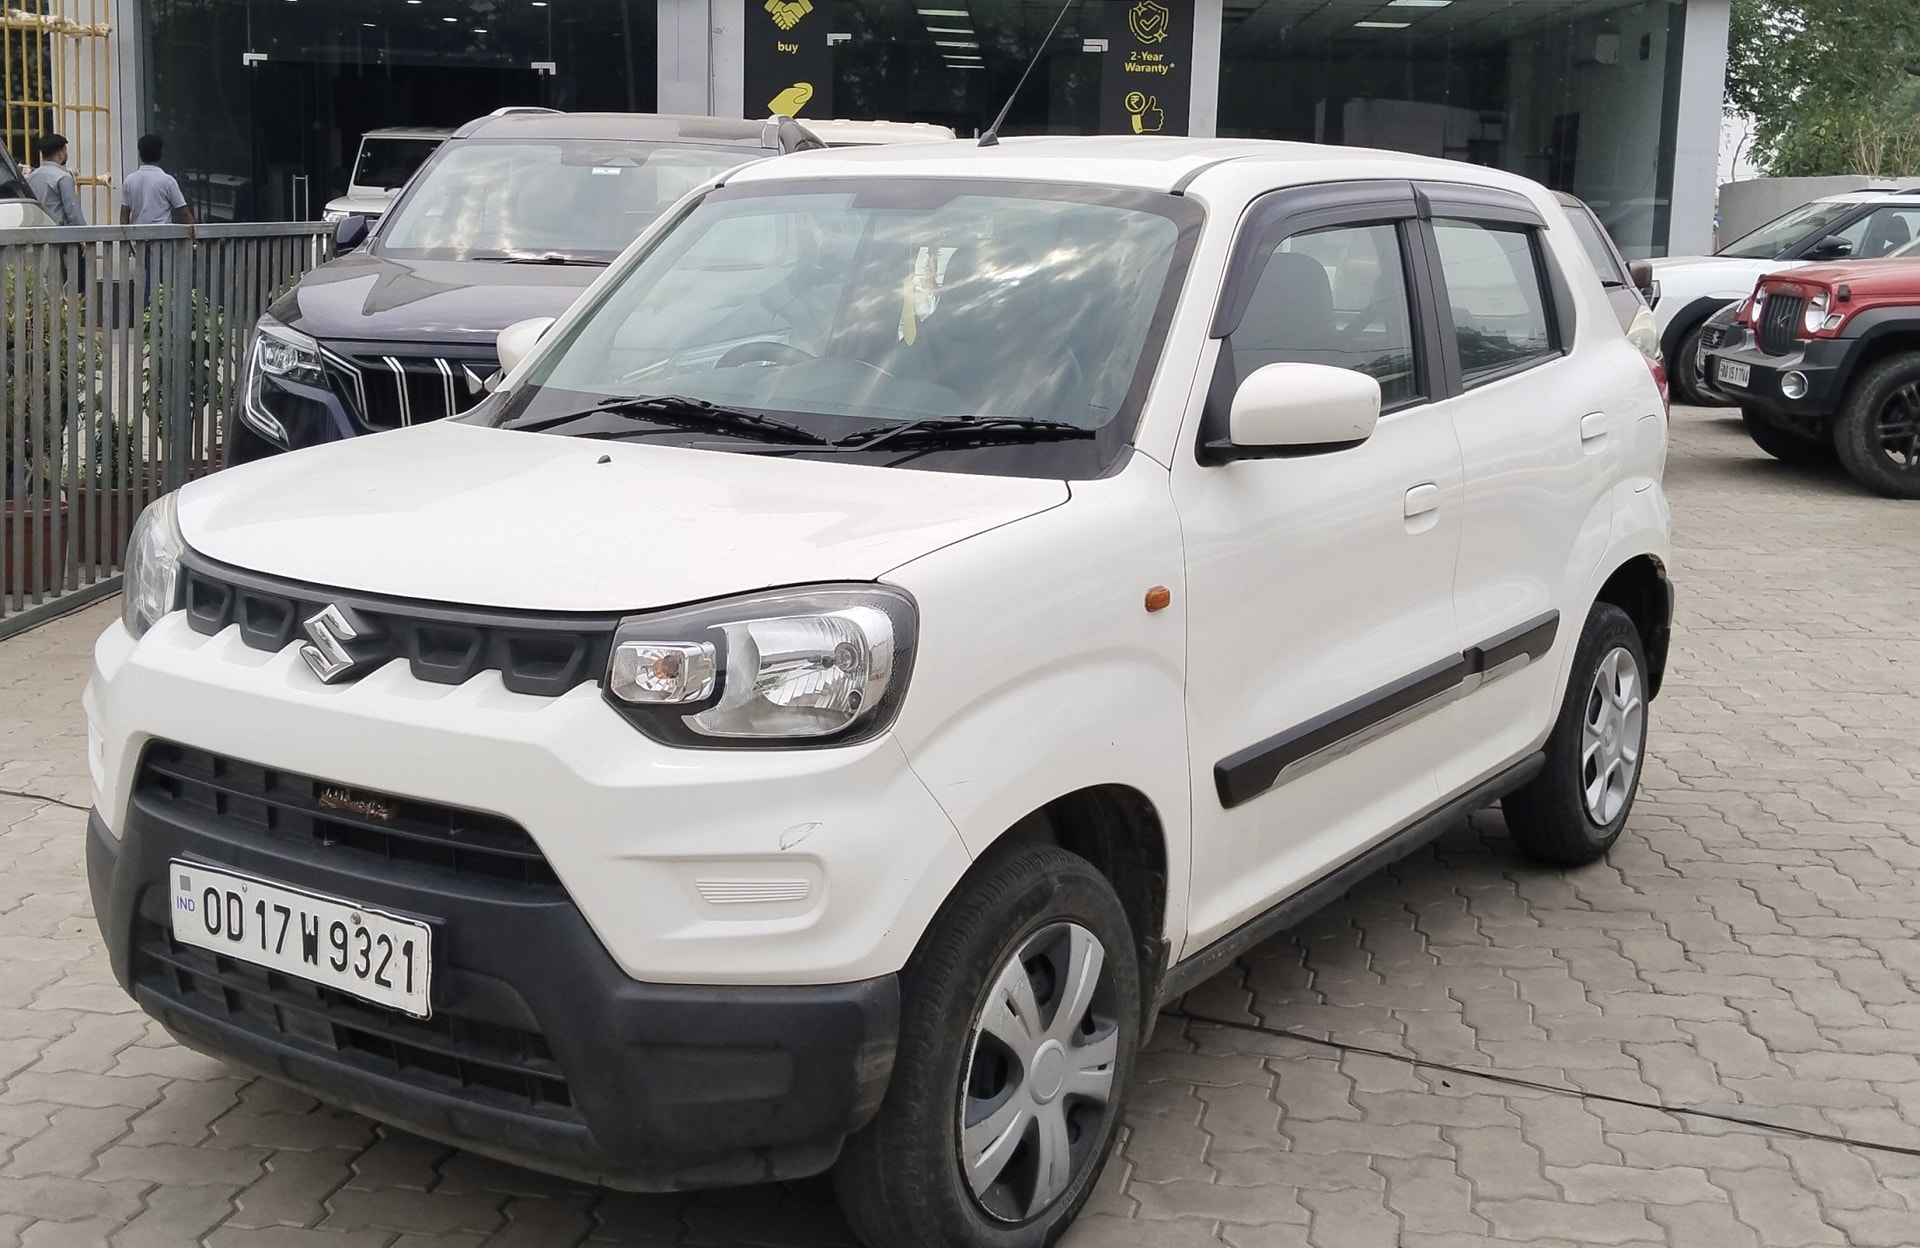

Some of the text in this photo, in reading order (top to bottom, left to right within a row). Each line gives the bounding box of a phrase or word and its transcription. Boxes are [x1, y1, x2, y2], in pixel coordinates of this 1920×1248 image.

[777, 40, 799, 55] buy
[1130, 51, 1164, 61] 2-Year
[176, 895, 195, 912] IND
